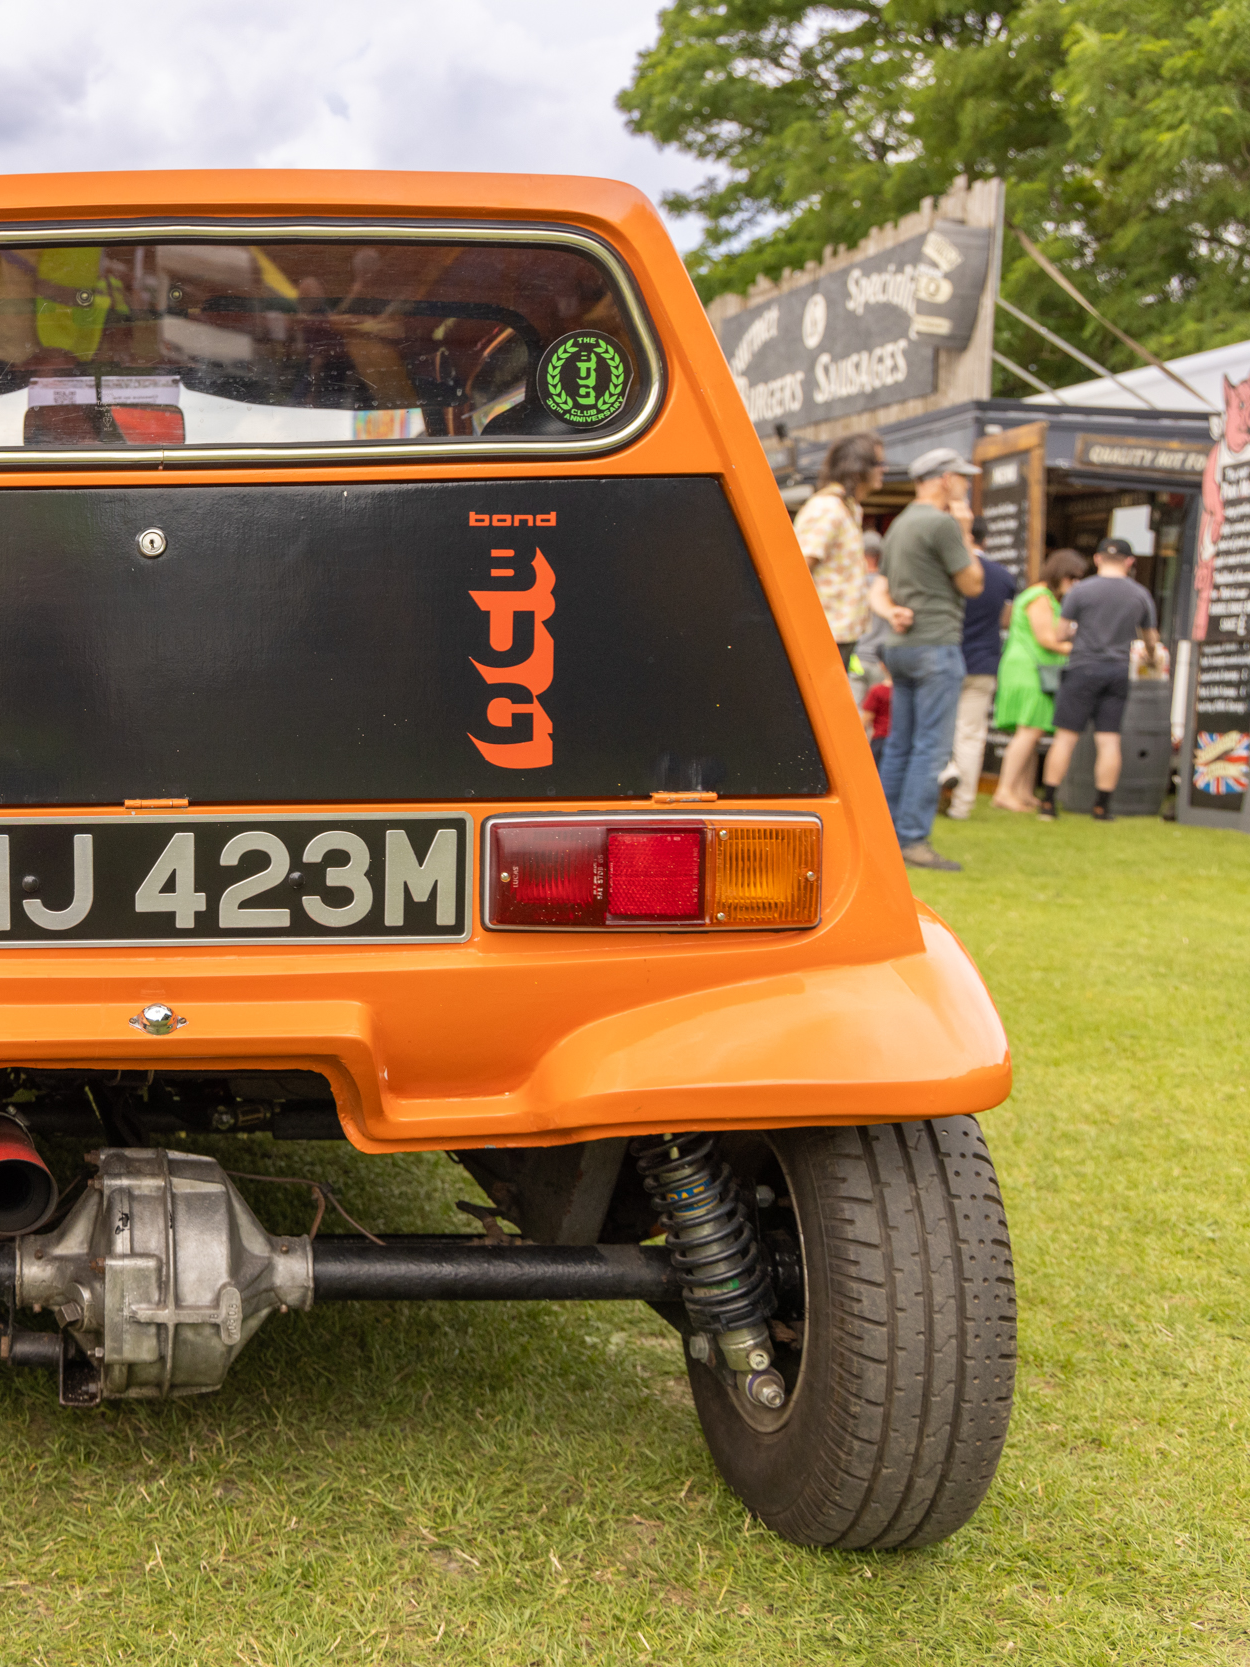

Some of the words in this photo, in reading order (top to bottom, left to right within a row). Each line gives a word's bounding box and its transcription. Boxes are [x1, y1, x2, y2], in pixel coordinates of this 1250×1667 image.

[813, 337, 909, 404] SAUSAGES
[563, 395, 625, 423] ANNIVERSARY
[570, 408, 597, 416] CLUB
[1089, 444, 1156, 467] QUALITY
[1153, 449, 1187, 470] HOT
[1184, 452, 1208, 472] FO
[468, 511, 557, 527] bond
[466, 546, 556, 770] BUG
[134, 828, 458, 930] 423M
